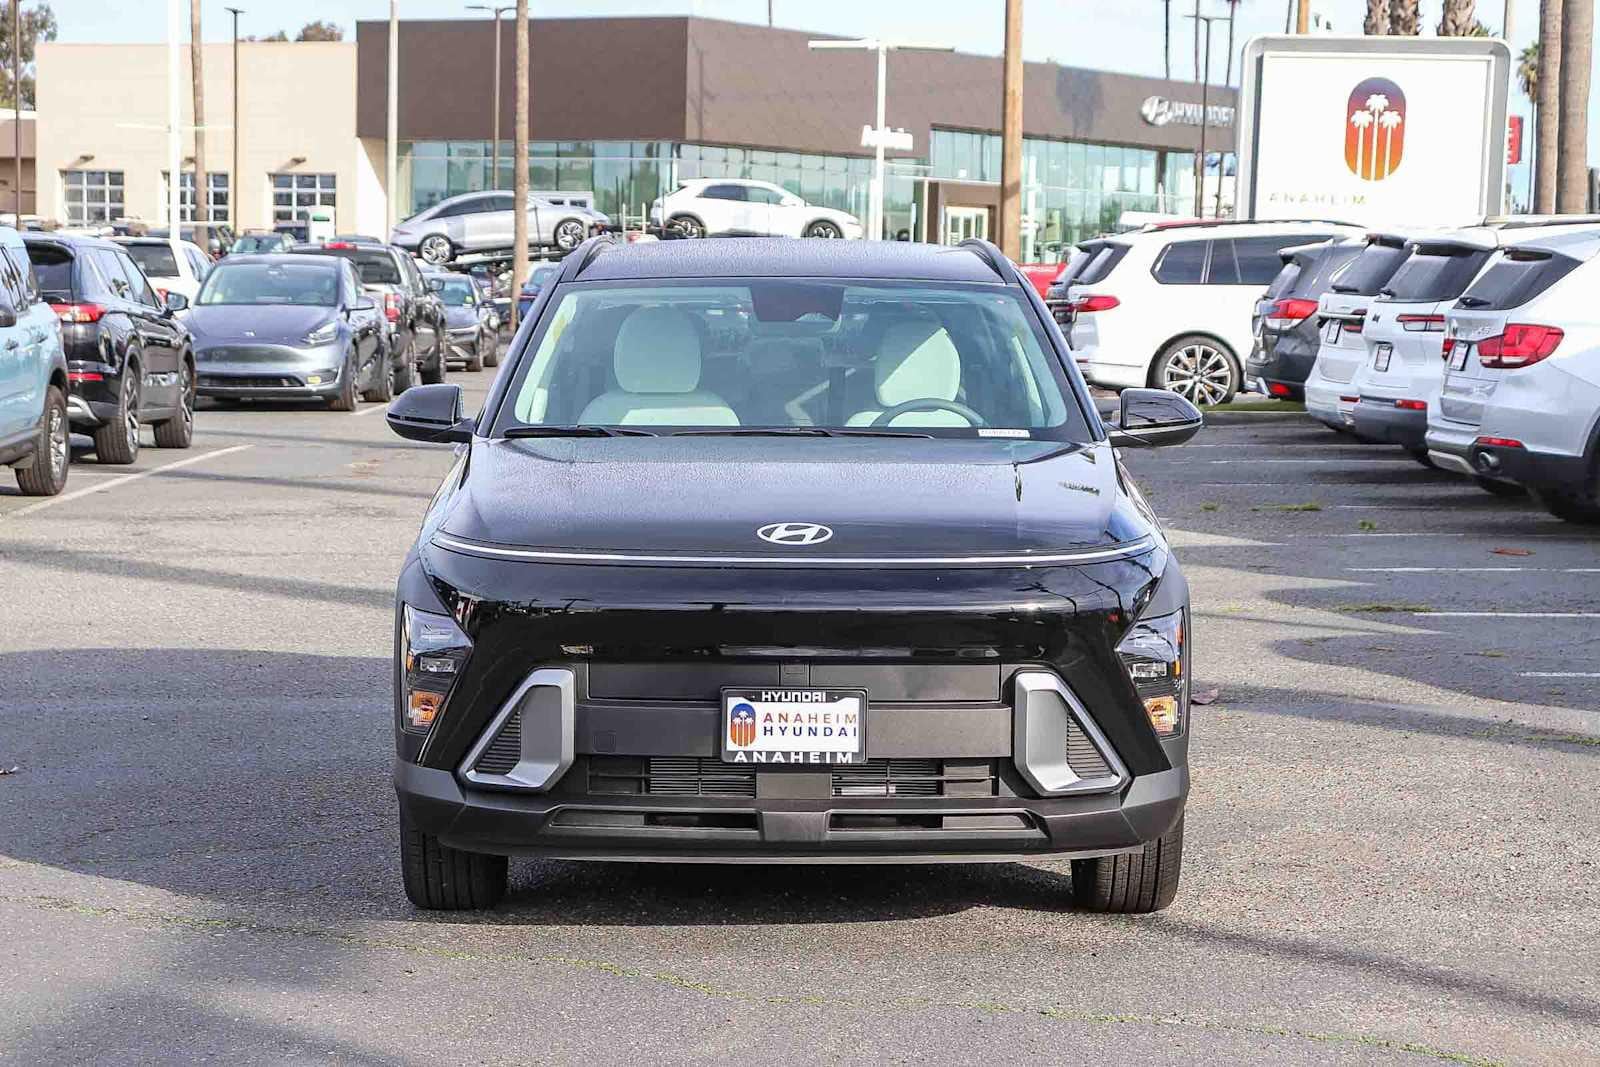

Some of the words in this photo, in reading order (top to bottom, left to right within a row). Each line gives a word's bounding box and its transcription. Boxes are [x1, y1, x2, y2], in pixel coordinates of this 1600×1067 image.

[761, 691, 827, 702] HYUNDAI
[763, 712, 857, 724] ANAHEIM
[763, 726, 857, 737] HYUNDAI
[734, 751, 853, 763] ANAHEIM
